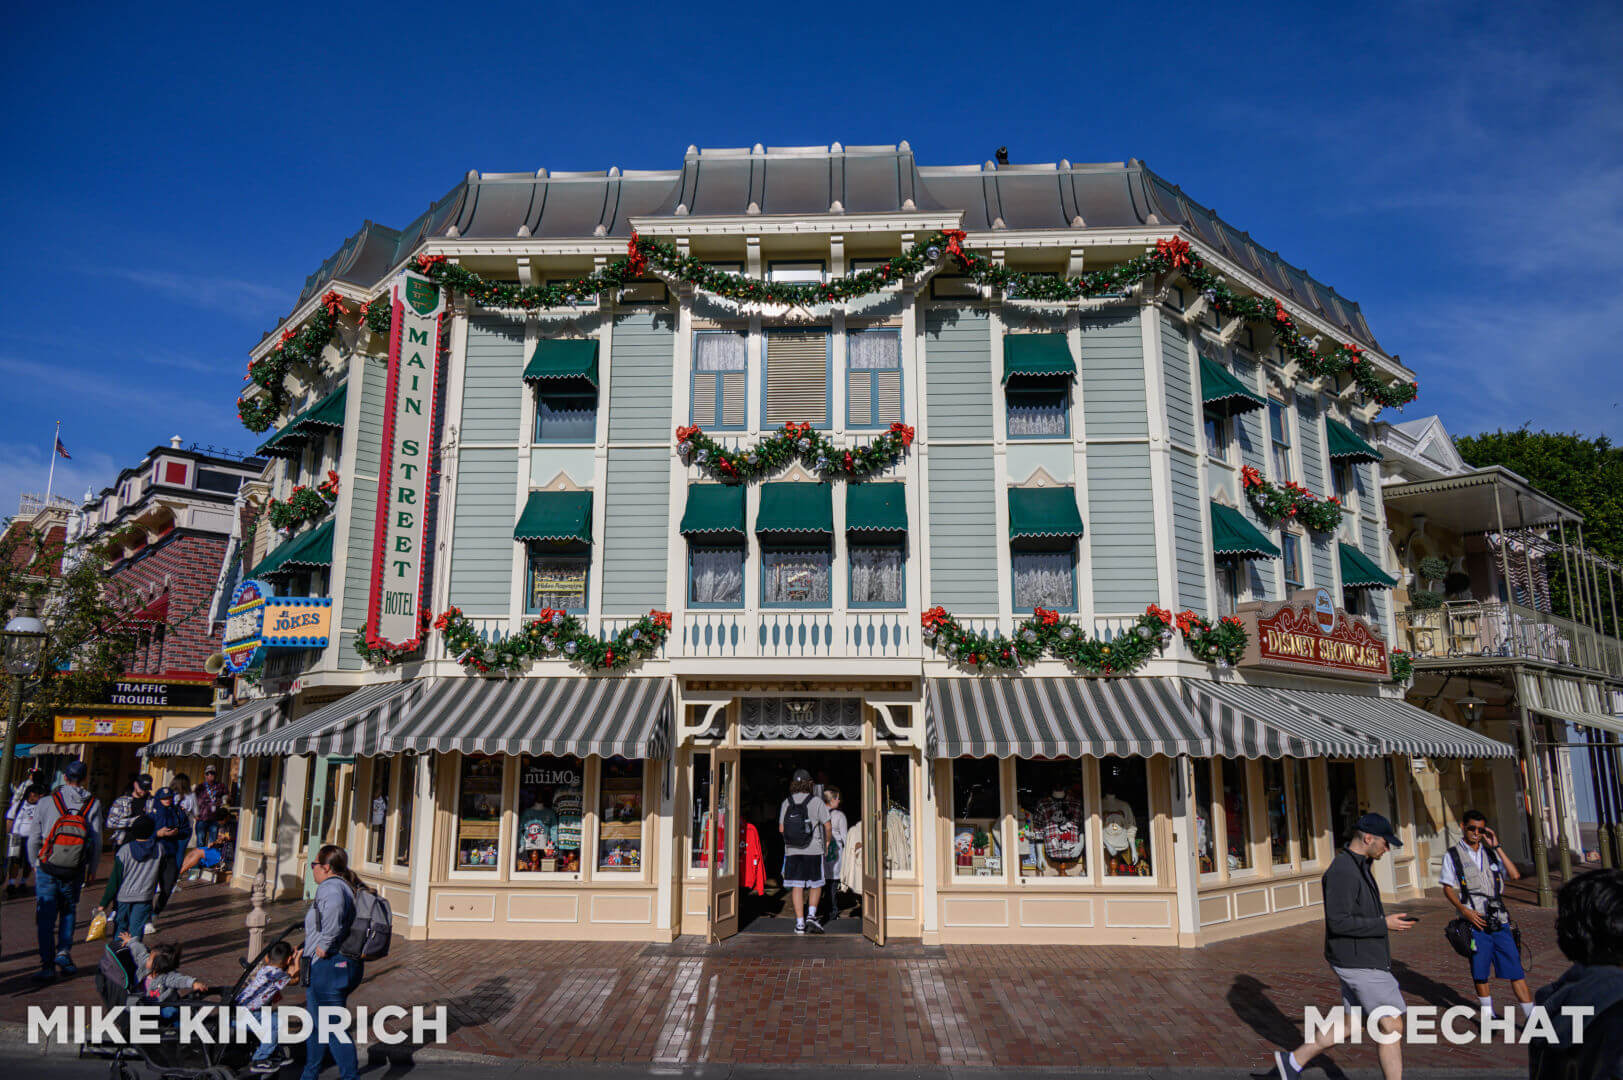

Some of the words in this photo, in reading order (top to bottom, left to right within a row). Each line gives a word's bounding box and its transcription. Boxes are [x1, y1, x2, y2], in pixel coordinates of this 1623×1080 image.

[404, 327, 429, 416] MAIN
[393, 439, 419, 578] STREET
[385, 590, 415, 616] HOTEL
[273, 612, 320, 632] JOKES
[1267, 630, 1315, 659] DISNEY
[1319, 637, 1381, 667] SHOWCASE
[111, 694, 168, 705] TROUBLE
[116, 682, 168, 694] TRAFFIC
[525, 770, 581, 785] nuiMOs
